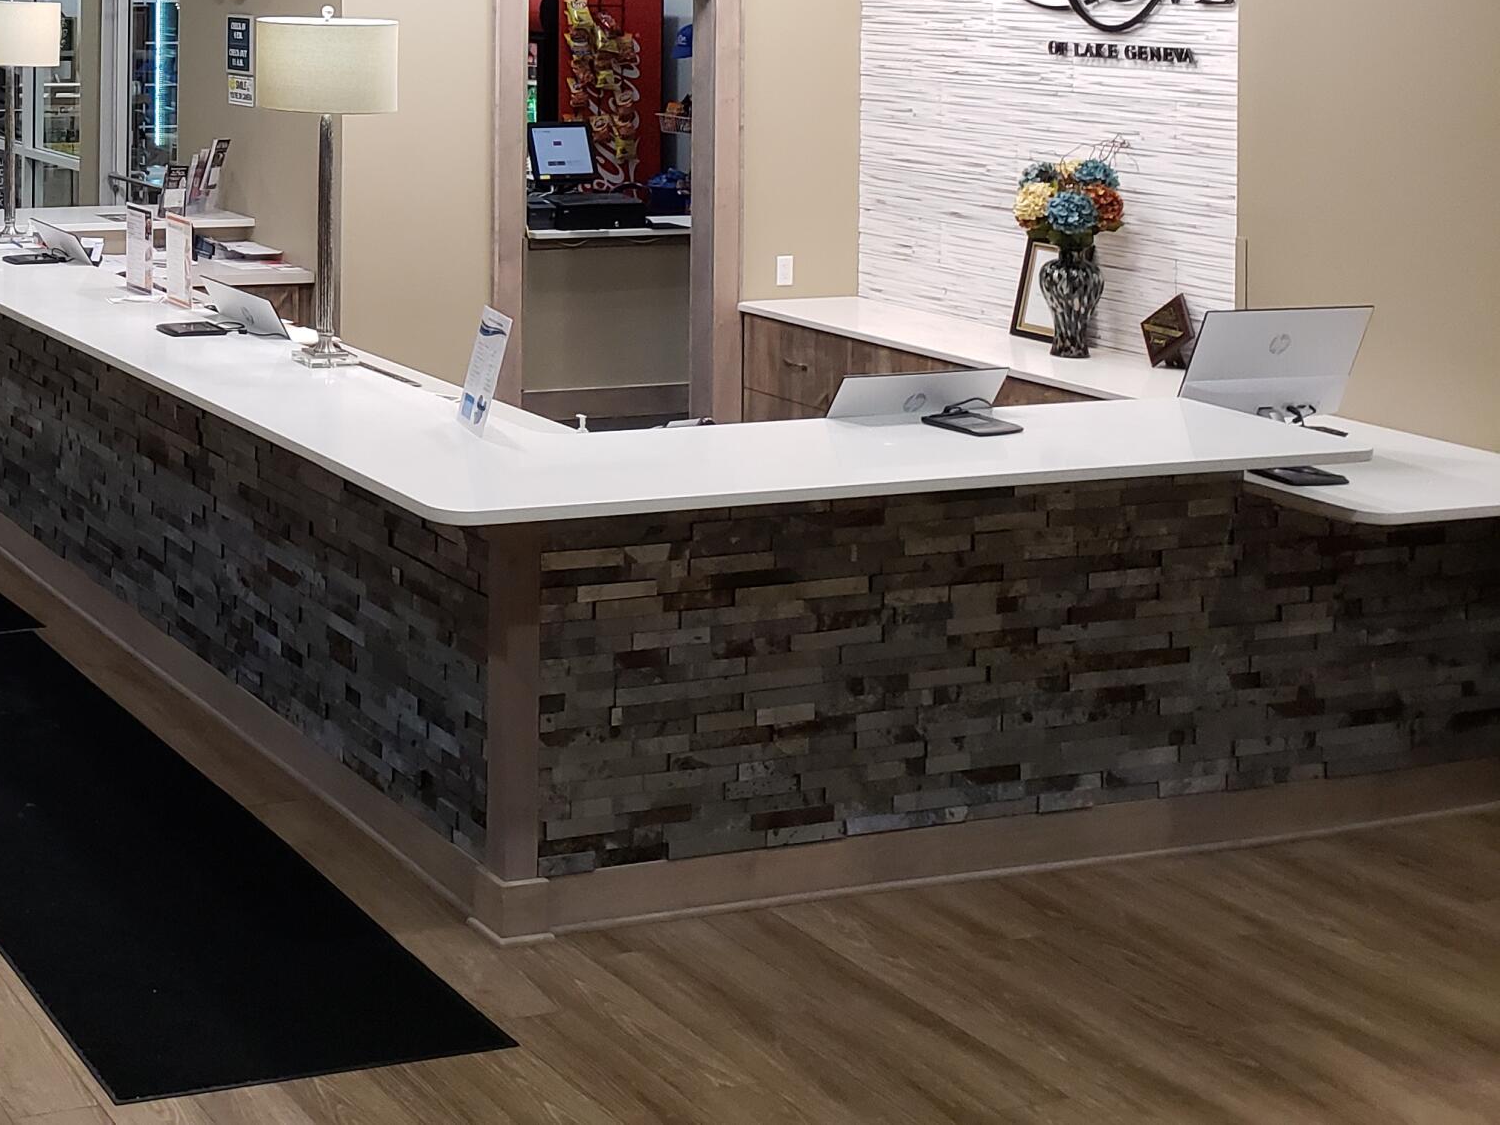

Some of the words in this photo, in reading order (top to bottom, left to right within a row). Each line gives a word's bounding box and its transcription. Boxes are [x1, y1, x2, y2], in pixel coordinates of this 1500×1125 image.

[1048, 41, 1068, 56] OF
[1074, 42, 1118, 59] LAKE
[1124, 45, 1193, 63] GENEVA
